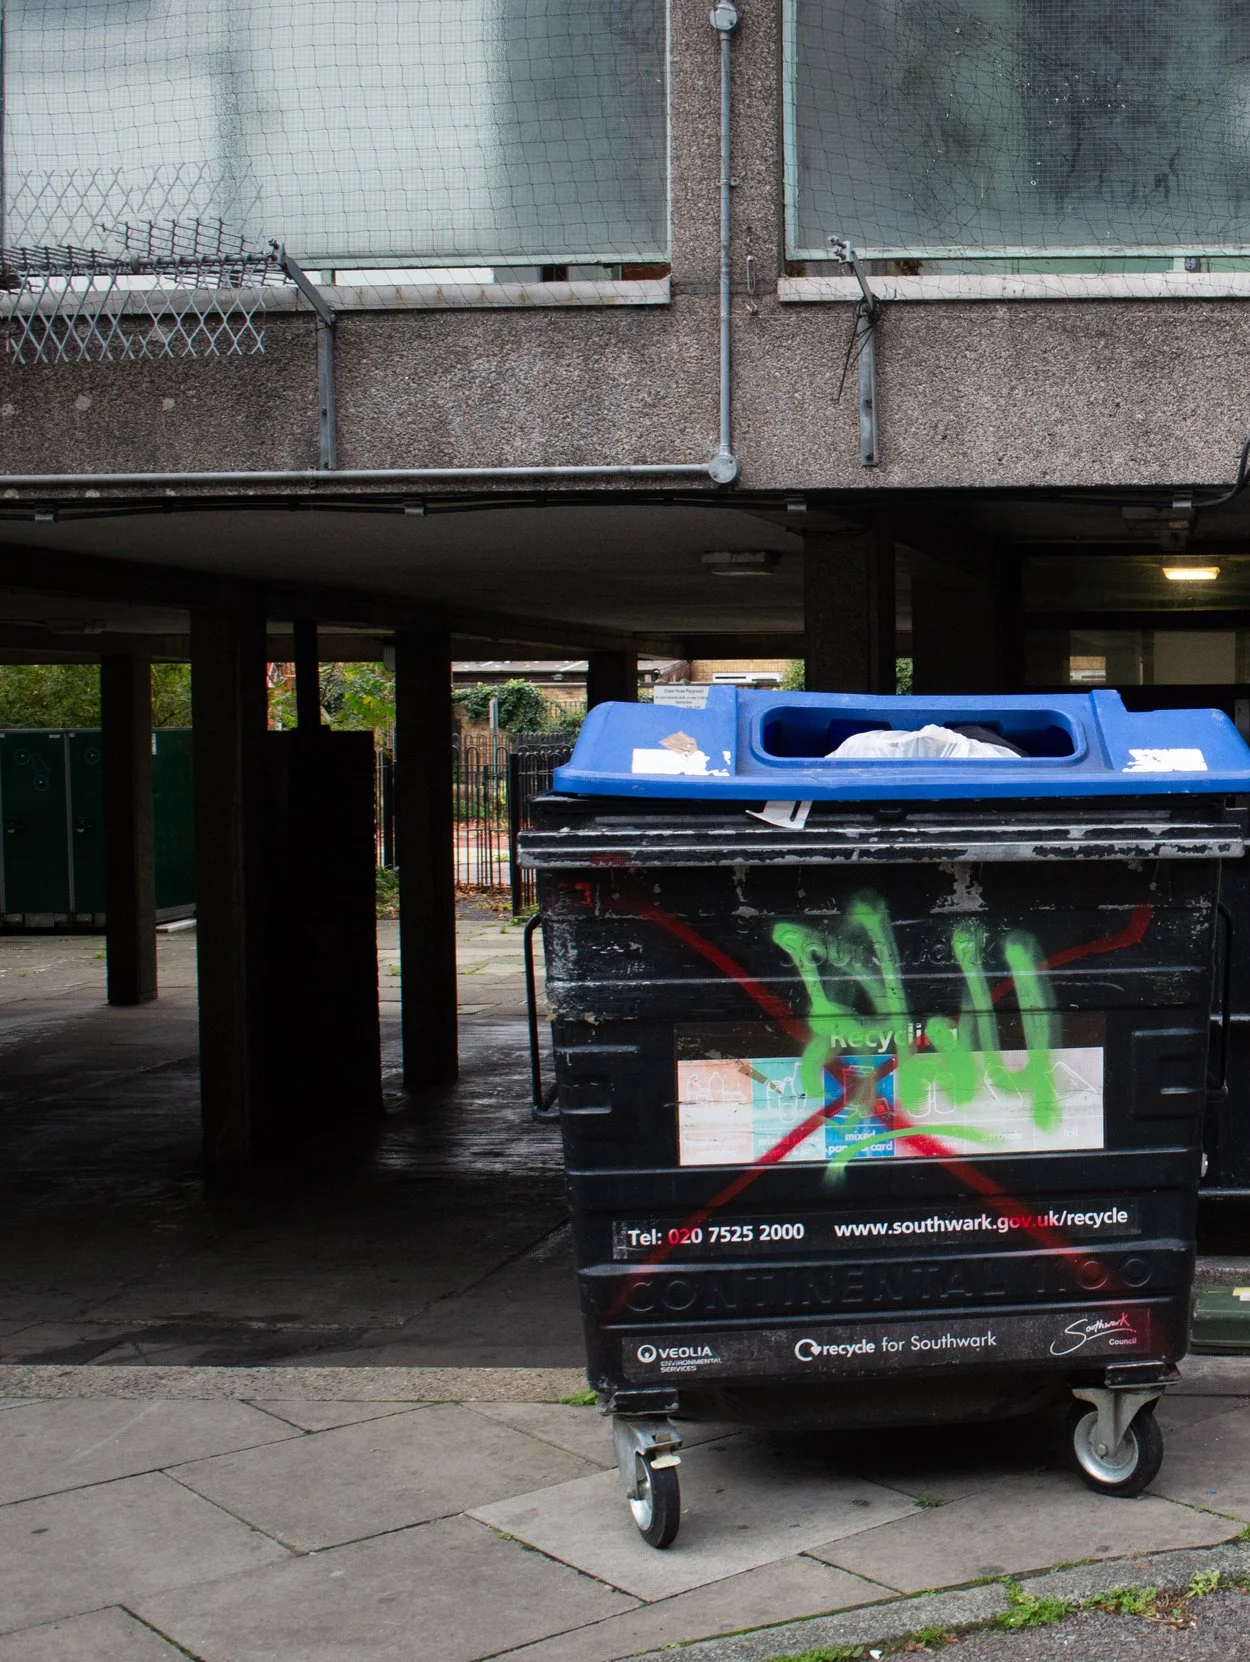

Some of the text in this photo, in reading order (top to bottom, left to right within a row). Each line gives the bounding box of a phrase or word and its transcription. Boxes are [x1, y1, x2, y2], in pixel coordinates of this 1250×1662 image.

[830, 1021, 958, 1053] Recyclig
[870, 1140, 893, 1151] card
[628, 1207, 1128, 1246] Tel: 020 7525 2000 www.southwark.gov.uk/recycle
[626, 1262, 1006, 1312] CONTINENTAL
[823, 1331, 997, 1357] recycle for Southwark
[1109, 1337, 1137, 1346] Council
[658, 1346, 713, 1359] VEOLIA
[660, 1357, 723, 1367] ENVIRONMENTAL
[660, 1365, 697, 1373] SERVICES
